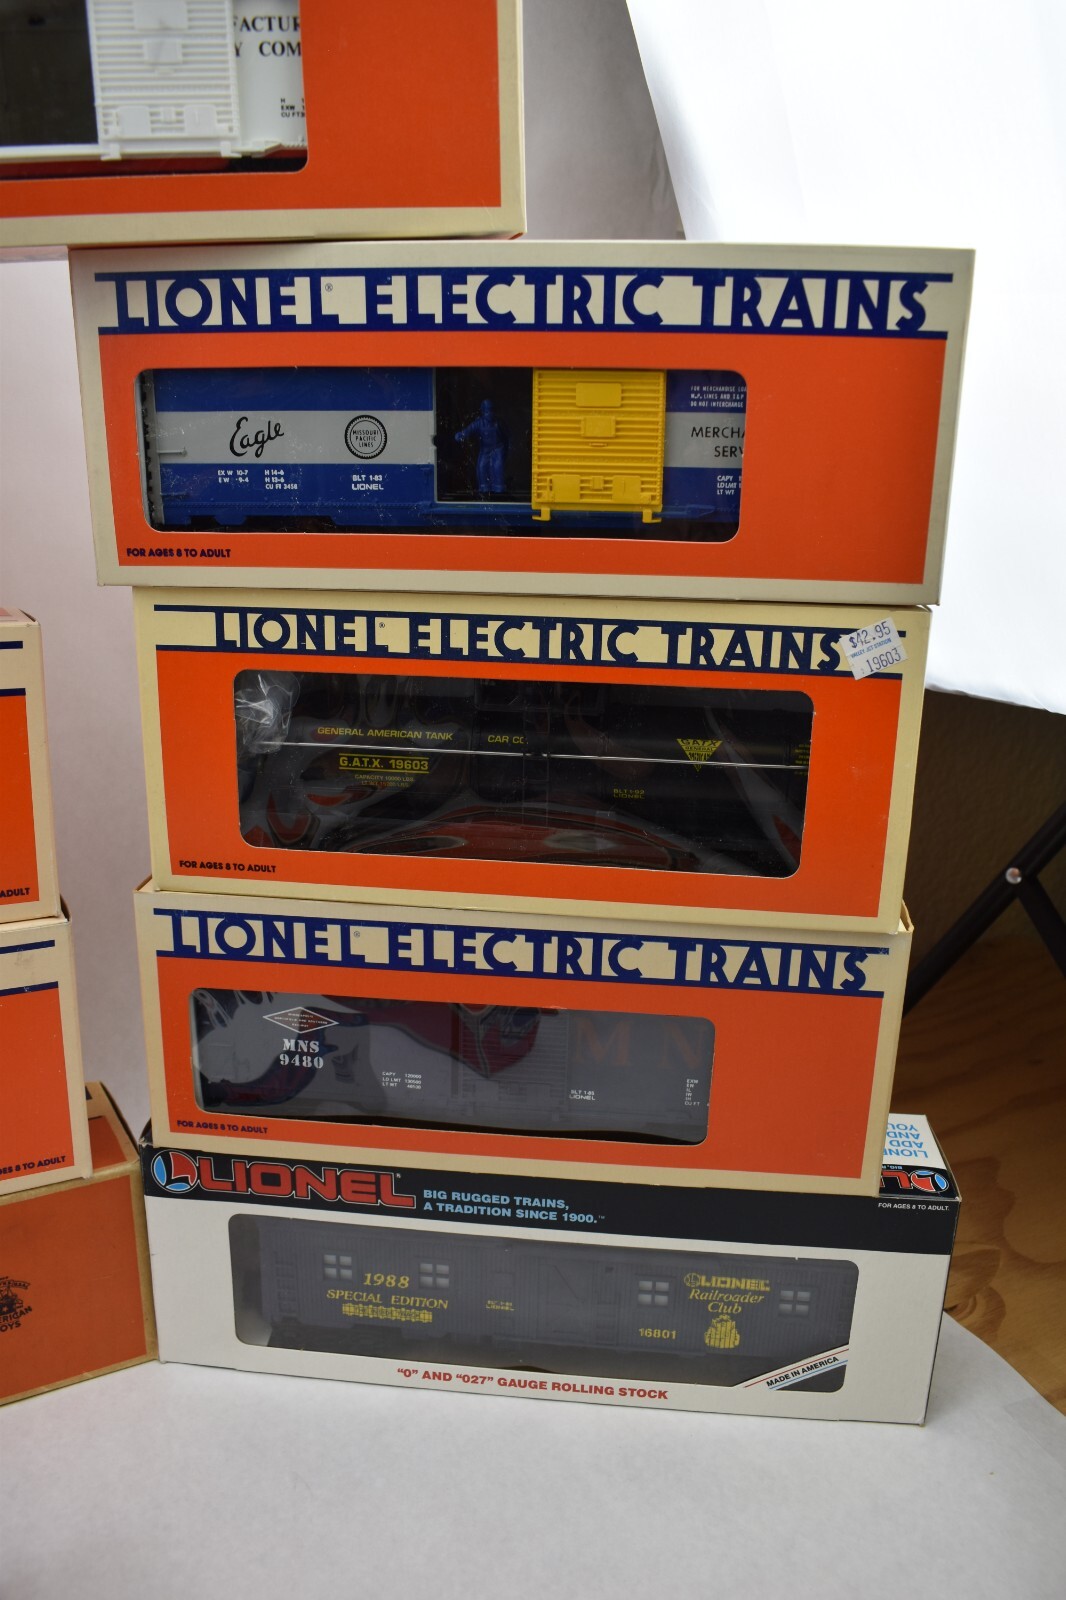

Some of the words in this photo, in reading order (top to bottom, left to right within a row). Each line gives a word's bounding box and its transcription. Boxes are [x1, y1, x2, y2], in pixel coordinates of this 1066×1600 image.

[366, 267, 664, 333] ELECTRIC
[692, 270, 929, 338] TRAINS
[229, 416, 285, 459] Eagle
[127, 548, 146, 557] FOR
[148, 548, 174, 557] AGES
[176, 548, 182, 557] 8
[184, 549, 198, 557] TO
[200, 549, 231, 558] ADULT
[849, 621, 891, 648] $42.95
[409, 614, 640, 666] ELECTRIC
[661, 620, 844, 673] TRAINS
[866, 647, 901, 672] 19603
[317, 727, 364, 736] GENERAL
[367, 729, 422, 739] AMERICAN
[425, 731, 454, 740] TANK
[487, 735, 509, 743] CAR
[339, 757, 384, 768] G.A.T.X.
[389, 759, 429, 770] 19603
[179, 860, 197, 868] FOR
[200, 861, 224, 870] AGES
[233, 863, 245, 871] TO
[247, 864, 276, 873] ADULT
[0, 887, 30, 898] ADULT
[387, 922, 645, 979] ELECTRIC
[667, 941, 869, 991] TRAINS
[283, 1038, 320, 1053] MNS
[280, 1053, 324, 1069] 9480
[177, 1120, 194, 1128] FOR
[196, 1122, 218, 1130] AGES
[241, 1125, 268, 1134] ADULT
[887, 1131, 920, 1140] AND
[889, 1140, 924, 1148] ADD
[22, 1162, 35, 1170] TO
[37, 1156, 66, 1167] ADULT
[197, 1156, 416, 1209] LIONEL
[423, 1189, 448, 1200] BIG
[451, 1191, 510, 1205] RUGGED
[513, 1196, 570, 1210] TRAINS,
[423, 1202, 433, 1211] A
[436, 1202, 511, 1217] TRADITION
[515, 1209, 558, 1221] SINCE
[363, 1273, 409, 1289] 1988
[700, 1275, 770, 1291] LIONEL
[326, 1289, 383, 1303] SPECIAL
[391, 1295, 449, 1310] EDITION
[689, 1288, 765, 1303] Railroader
[708, 1301, 742, 1314] Club
[639, 1328, 677, 1339] 16801
[766, 1373, 791, 1387] MADE
[791, 1369, 801, 1378] IN
[801, 1356, 840, 1374] AMERICA
[422, 1370, 452, 1382] AND
[497, 1377, 548, 1390] GAUGE
[551, 1381, 614, 1395] ROLLING
[618, 1387, 669, 1400] STOCK
